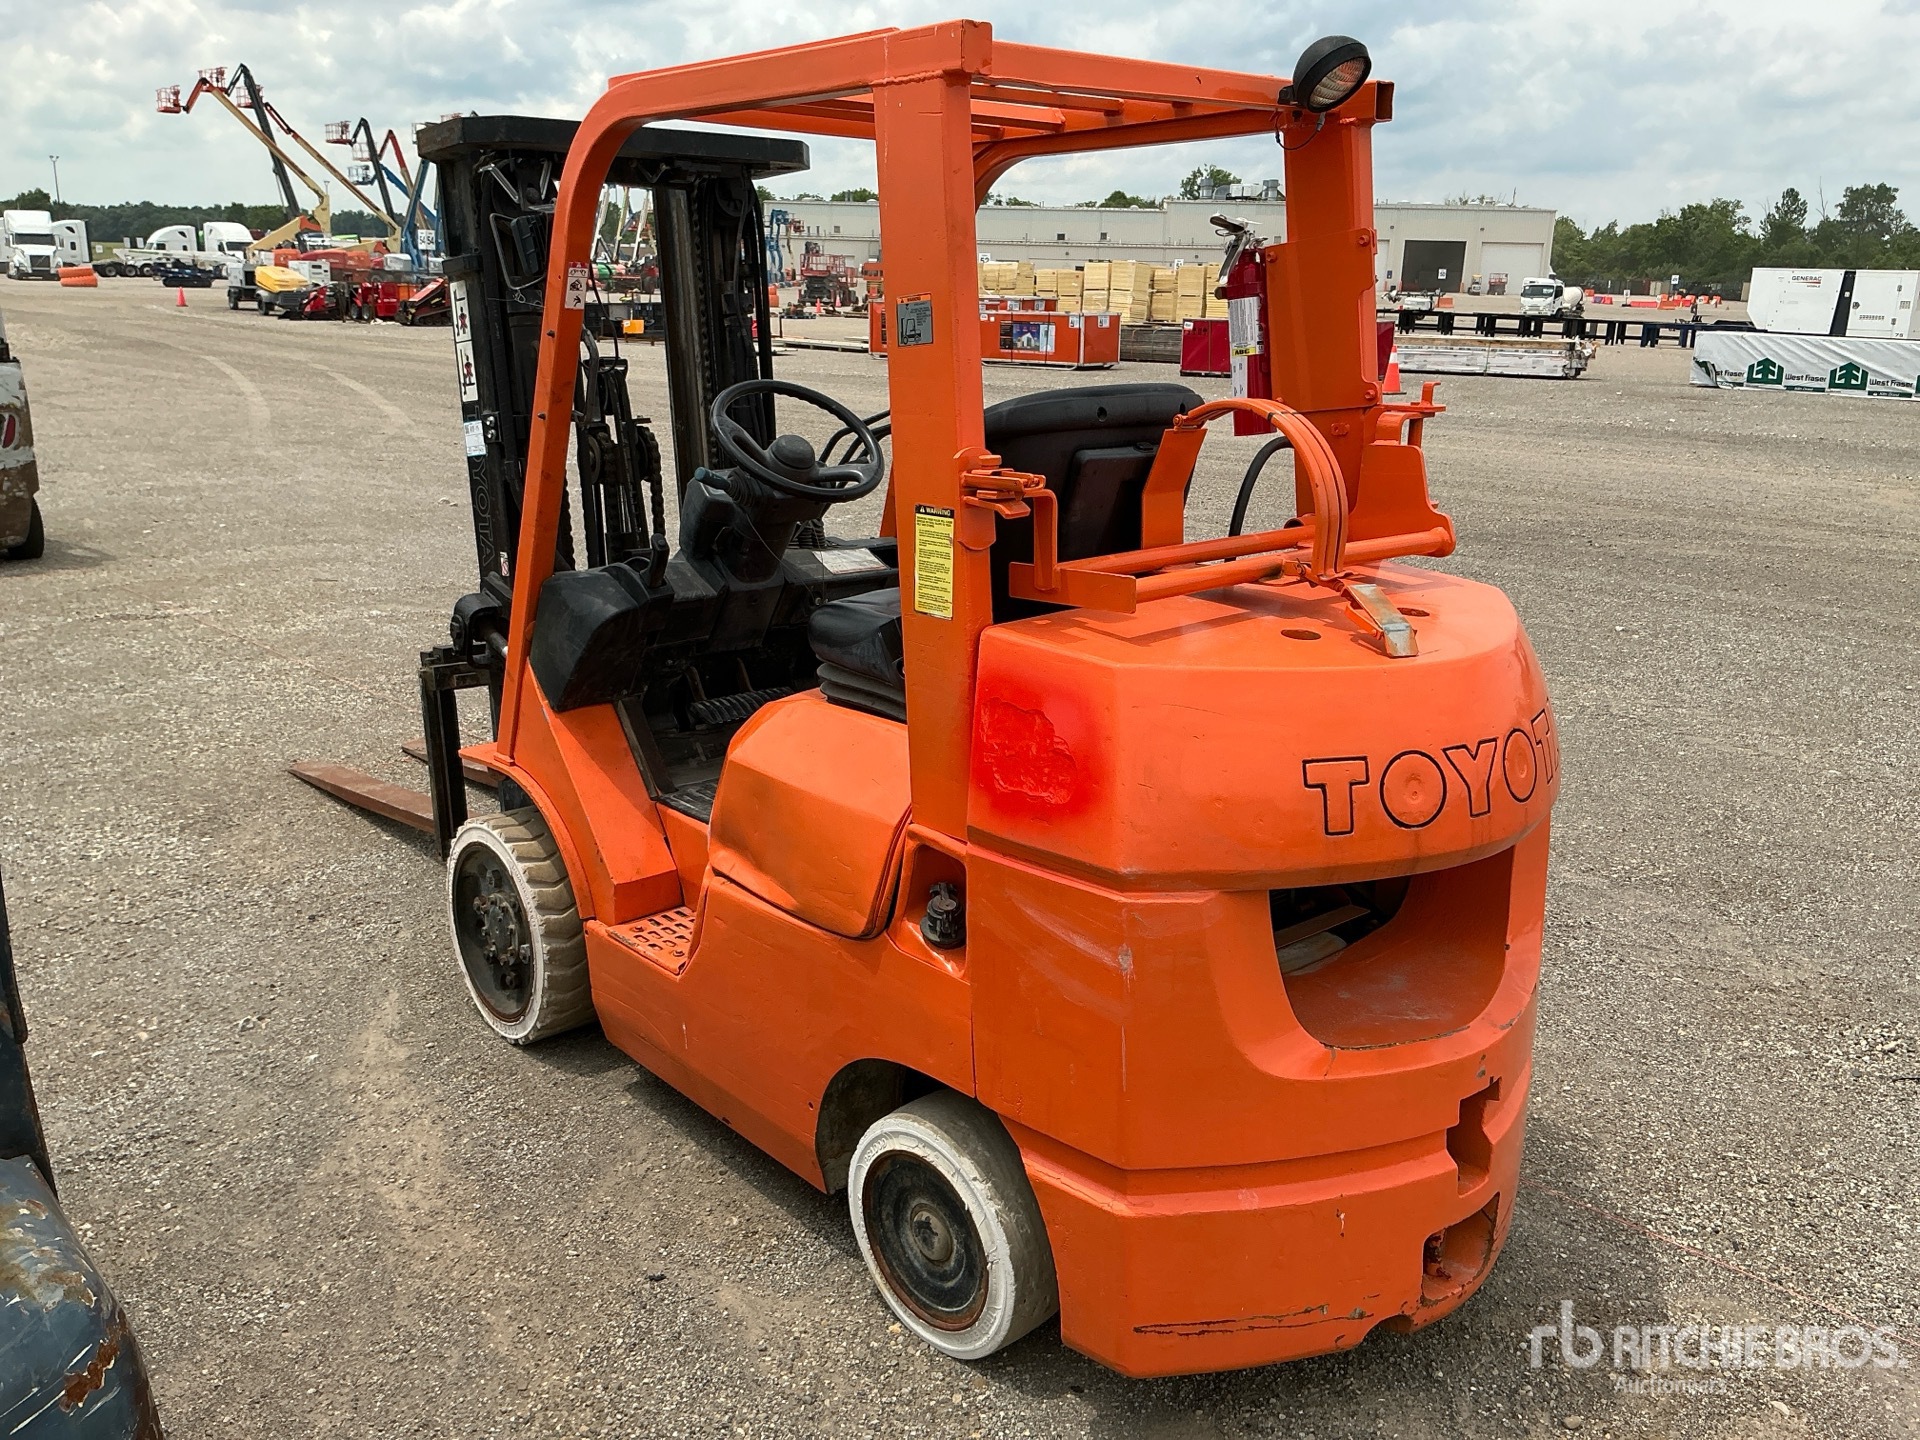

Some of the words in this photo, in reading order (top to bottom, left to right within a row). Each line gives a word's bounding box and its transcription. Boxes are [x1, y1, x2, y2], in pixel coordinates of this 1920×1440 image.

[1785, 373, 1804, 381] West
[1805, 374, 1827, 382] Fraser
[1869, 378, 1890, 387] West
[1890, 379, 1914, 388] Fraser
[466, 404, 496, 567] TYOTA
[1302, 700, 1560, 836] TOYOT
